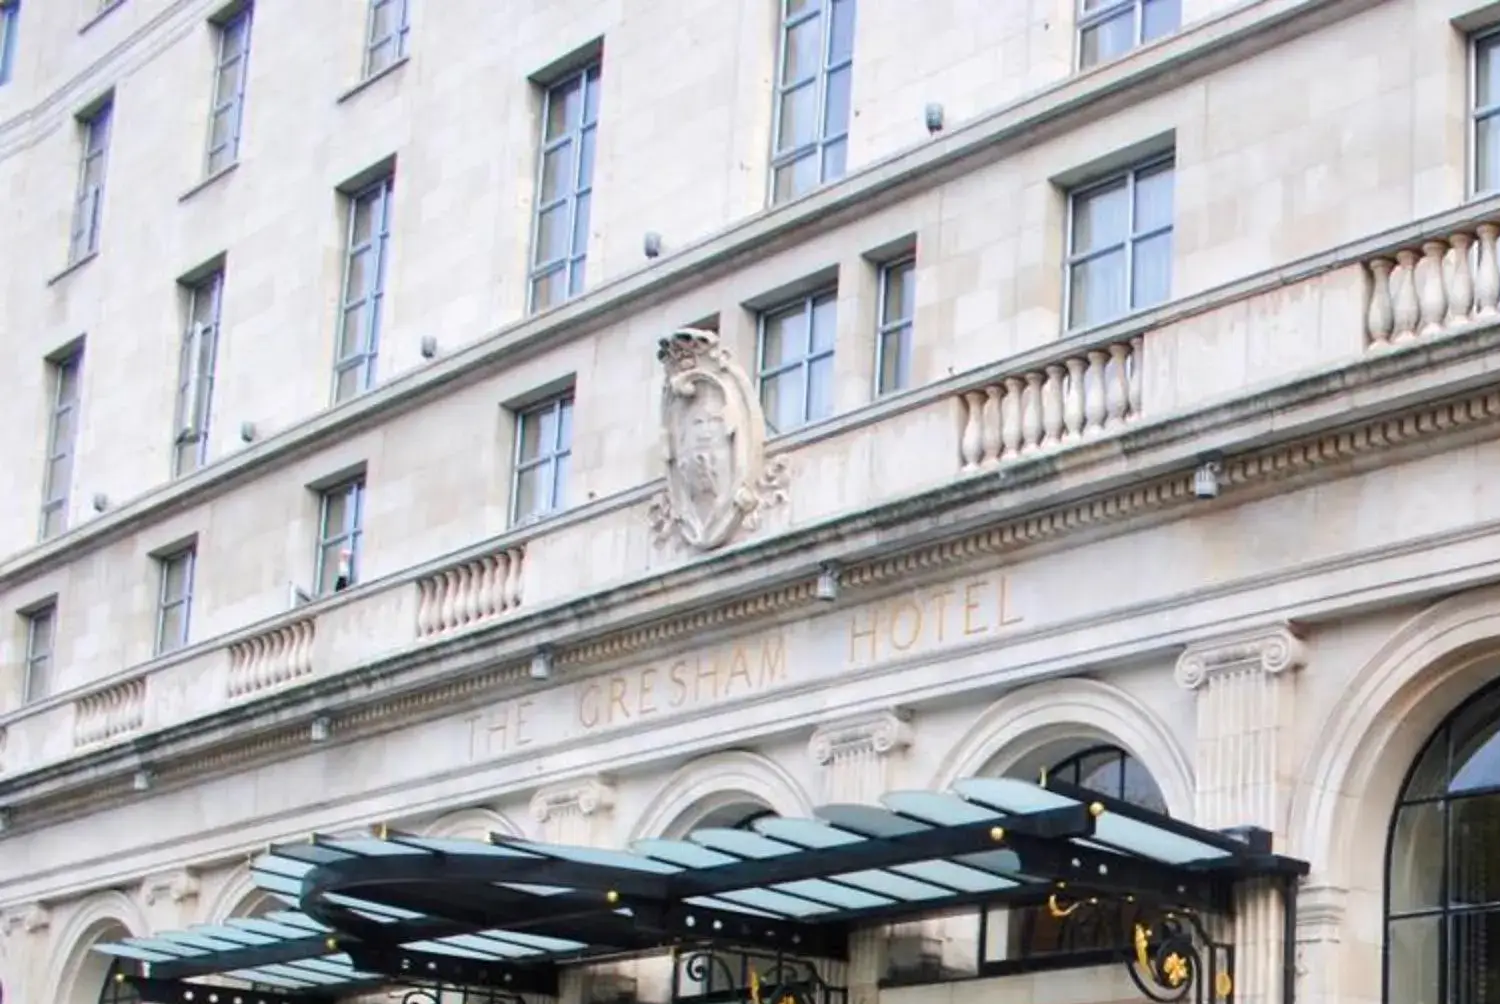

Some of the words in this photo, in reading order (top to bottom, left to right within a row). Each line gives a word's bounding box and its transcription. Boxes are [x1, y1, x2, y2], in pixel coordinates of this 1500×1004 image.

[463, 699, 534, 762] THE
[576, 634, 788, 729] GRESHAM
[849, 574, 1025, 663] HOTEL
